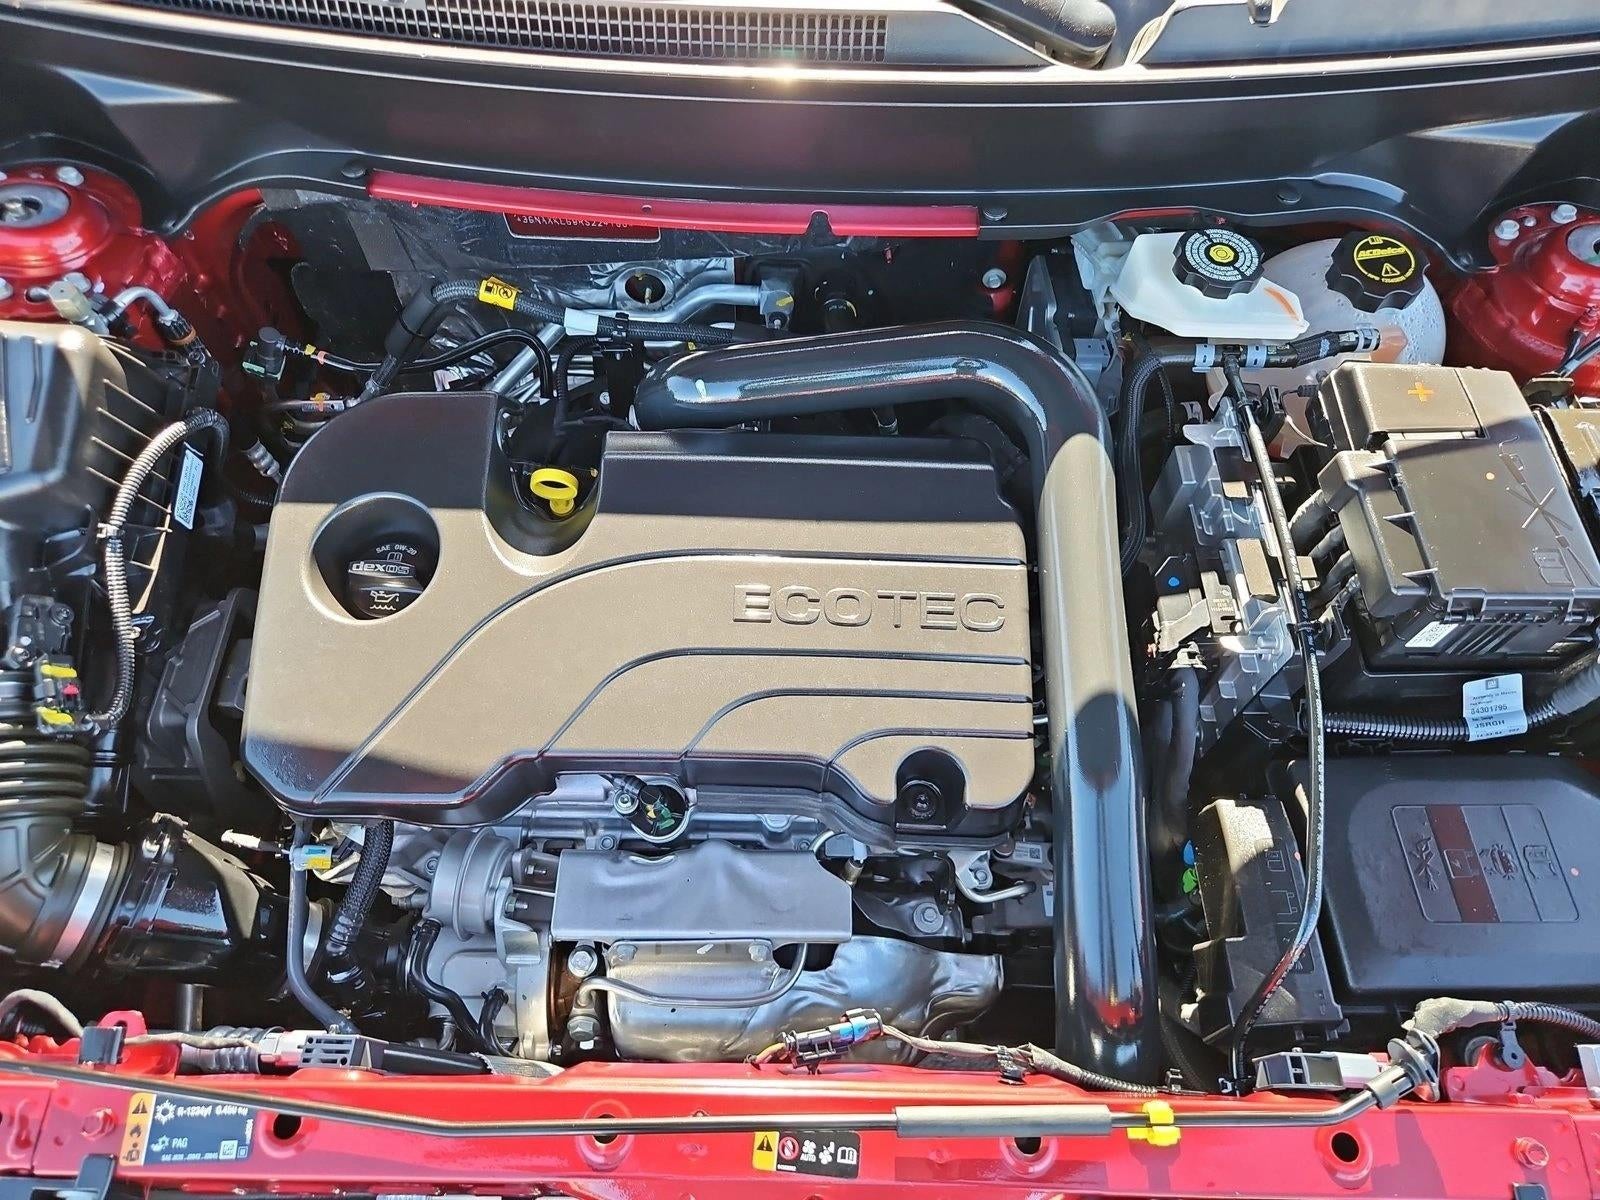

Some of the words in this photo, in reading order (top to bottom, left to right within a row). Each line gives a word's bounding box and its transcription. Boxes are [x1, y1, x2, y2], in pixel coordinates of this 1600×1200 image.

[1358, 247, 1406, 258] ACDelco
[375, 545, 391, 554] SAE
[352, 561, 410, 574] dexos
[733, 584, 1006, 632] ECOTEC
[171, 1137, 188, 1149] PAG
[800, 1153, 816, 1162] AUTO
